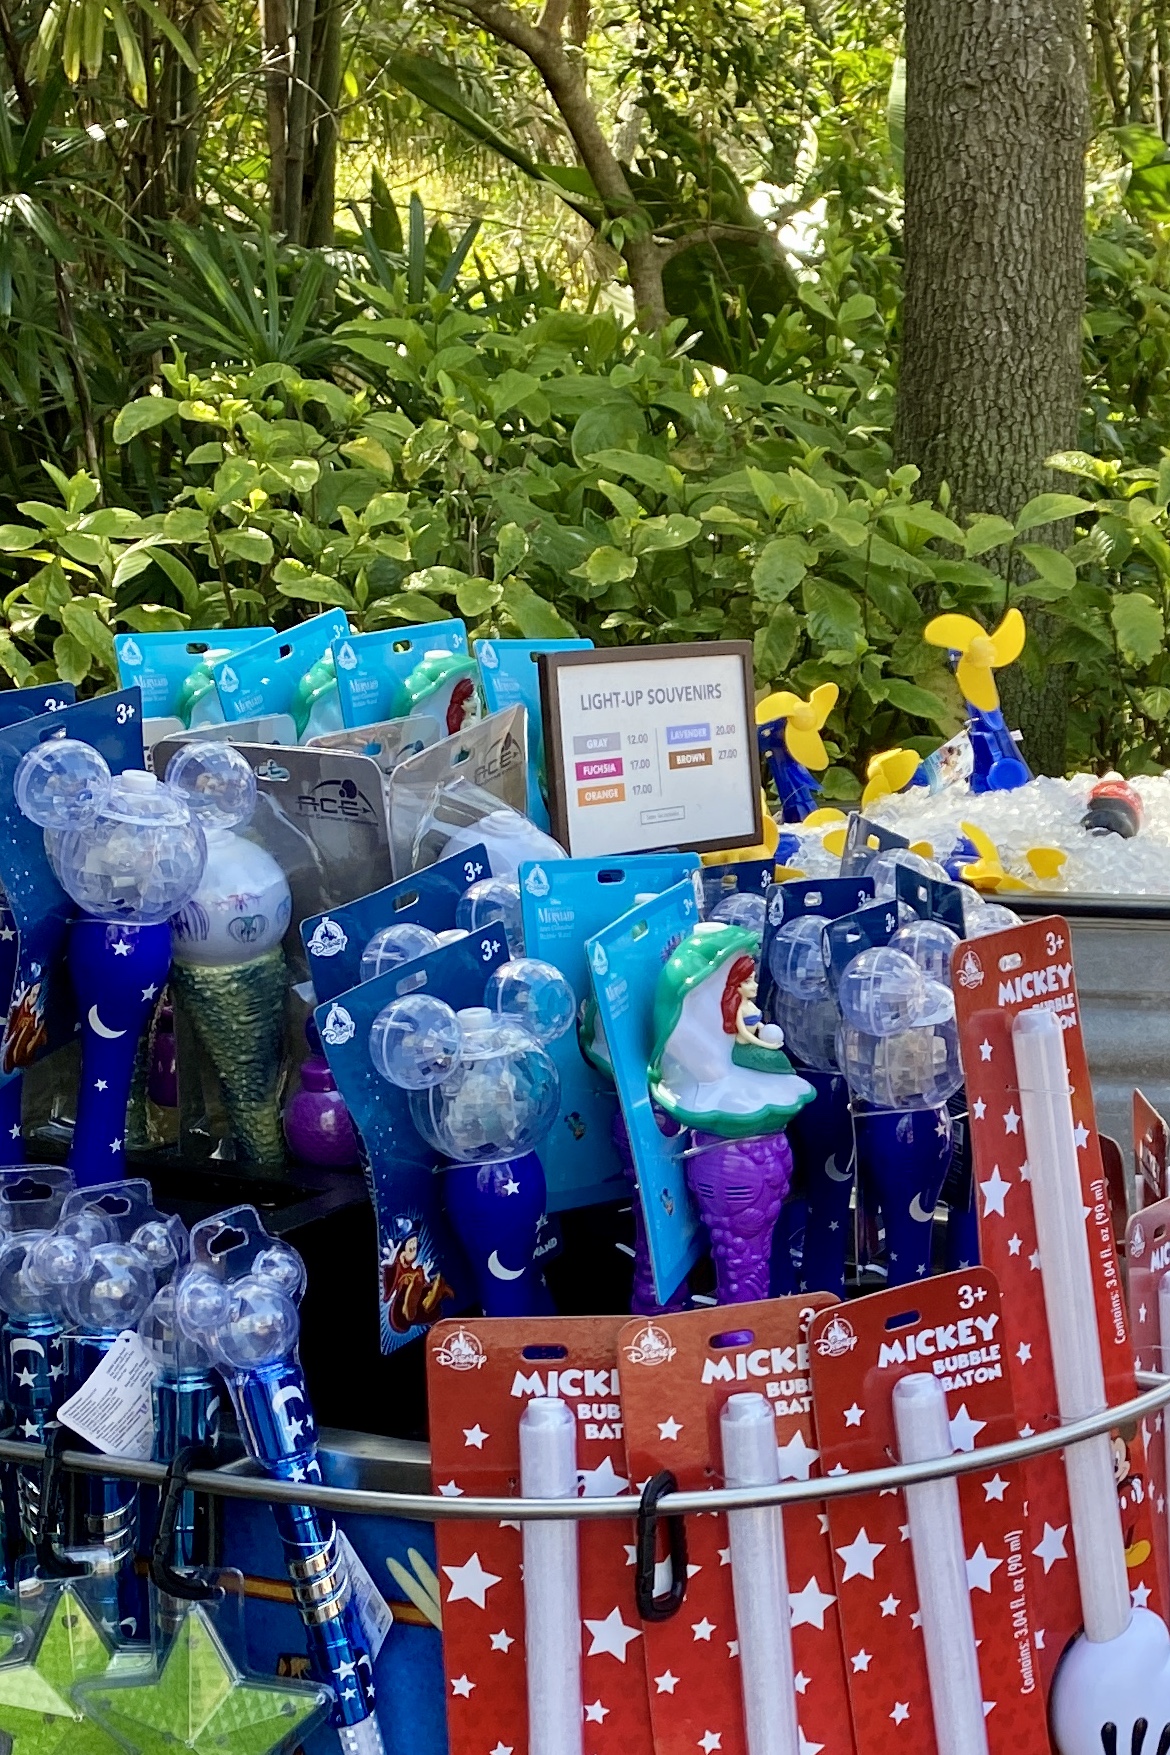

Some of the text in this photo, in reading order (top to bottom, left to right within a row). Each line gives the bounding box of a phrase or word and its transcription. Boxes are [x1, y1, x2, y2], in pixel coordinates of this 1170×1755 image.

[452, 633, 464, 649] 3+
[580, 683, 722, 711] LIGHT-UP SOUVENIRS
[116, 703, 135, 724] 3+
[586, 733, 649, 750] GRAY 12.00
[670, 724, 736, 740] LAVENDER 20.00
[583, 759, 651, 776] FUCHSIA 17.00
[676, 749, 738, 765] BROWN 27.00
[585, 783, 653, 802] ORANGE 17.00
[295, 795, 365, 817] ACE
[464, 862, 483, 882] 3+
[761, 869, 772, 888] 3+
[682, 898, 694, 916] 3+
[885, 912, 896, 932] 3+
[481, 940, 501, 961] 3+
[1045, 931, 1065, 956] 3+
[998, 962, 1073, 1006] MICKEY
[1090, 1179, 1126, 1345] Contains: 3.04 fl. oz (90 ml)
[957, 1284, 988, 1310] 3+
[878, 1312, 999, 1368] MICKEY
[701, 1343, 810, 1384] MICKE
[932, 1343, 1001, 1375] BUBBLE
[510, 1368, 620, 1398] MICK
[766, 1377, 813, 1398] BUB
[940, 1362, 1002, 1392] BATON
[577, 1403, 621, 1420] BUB
[774, 1395, 813, 1417] BAT
[585, 1422, 624, 1440] BAT
[1003, 1530, 1036, 1694] Contains: 3.04 fl. oz (90 ml)
